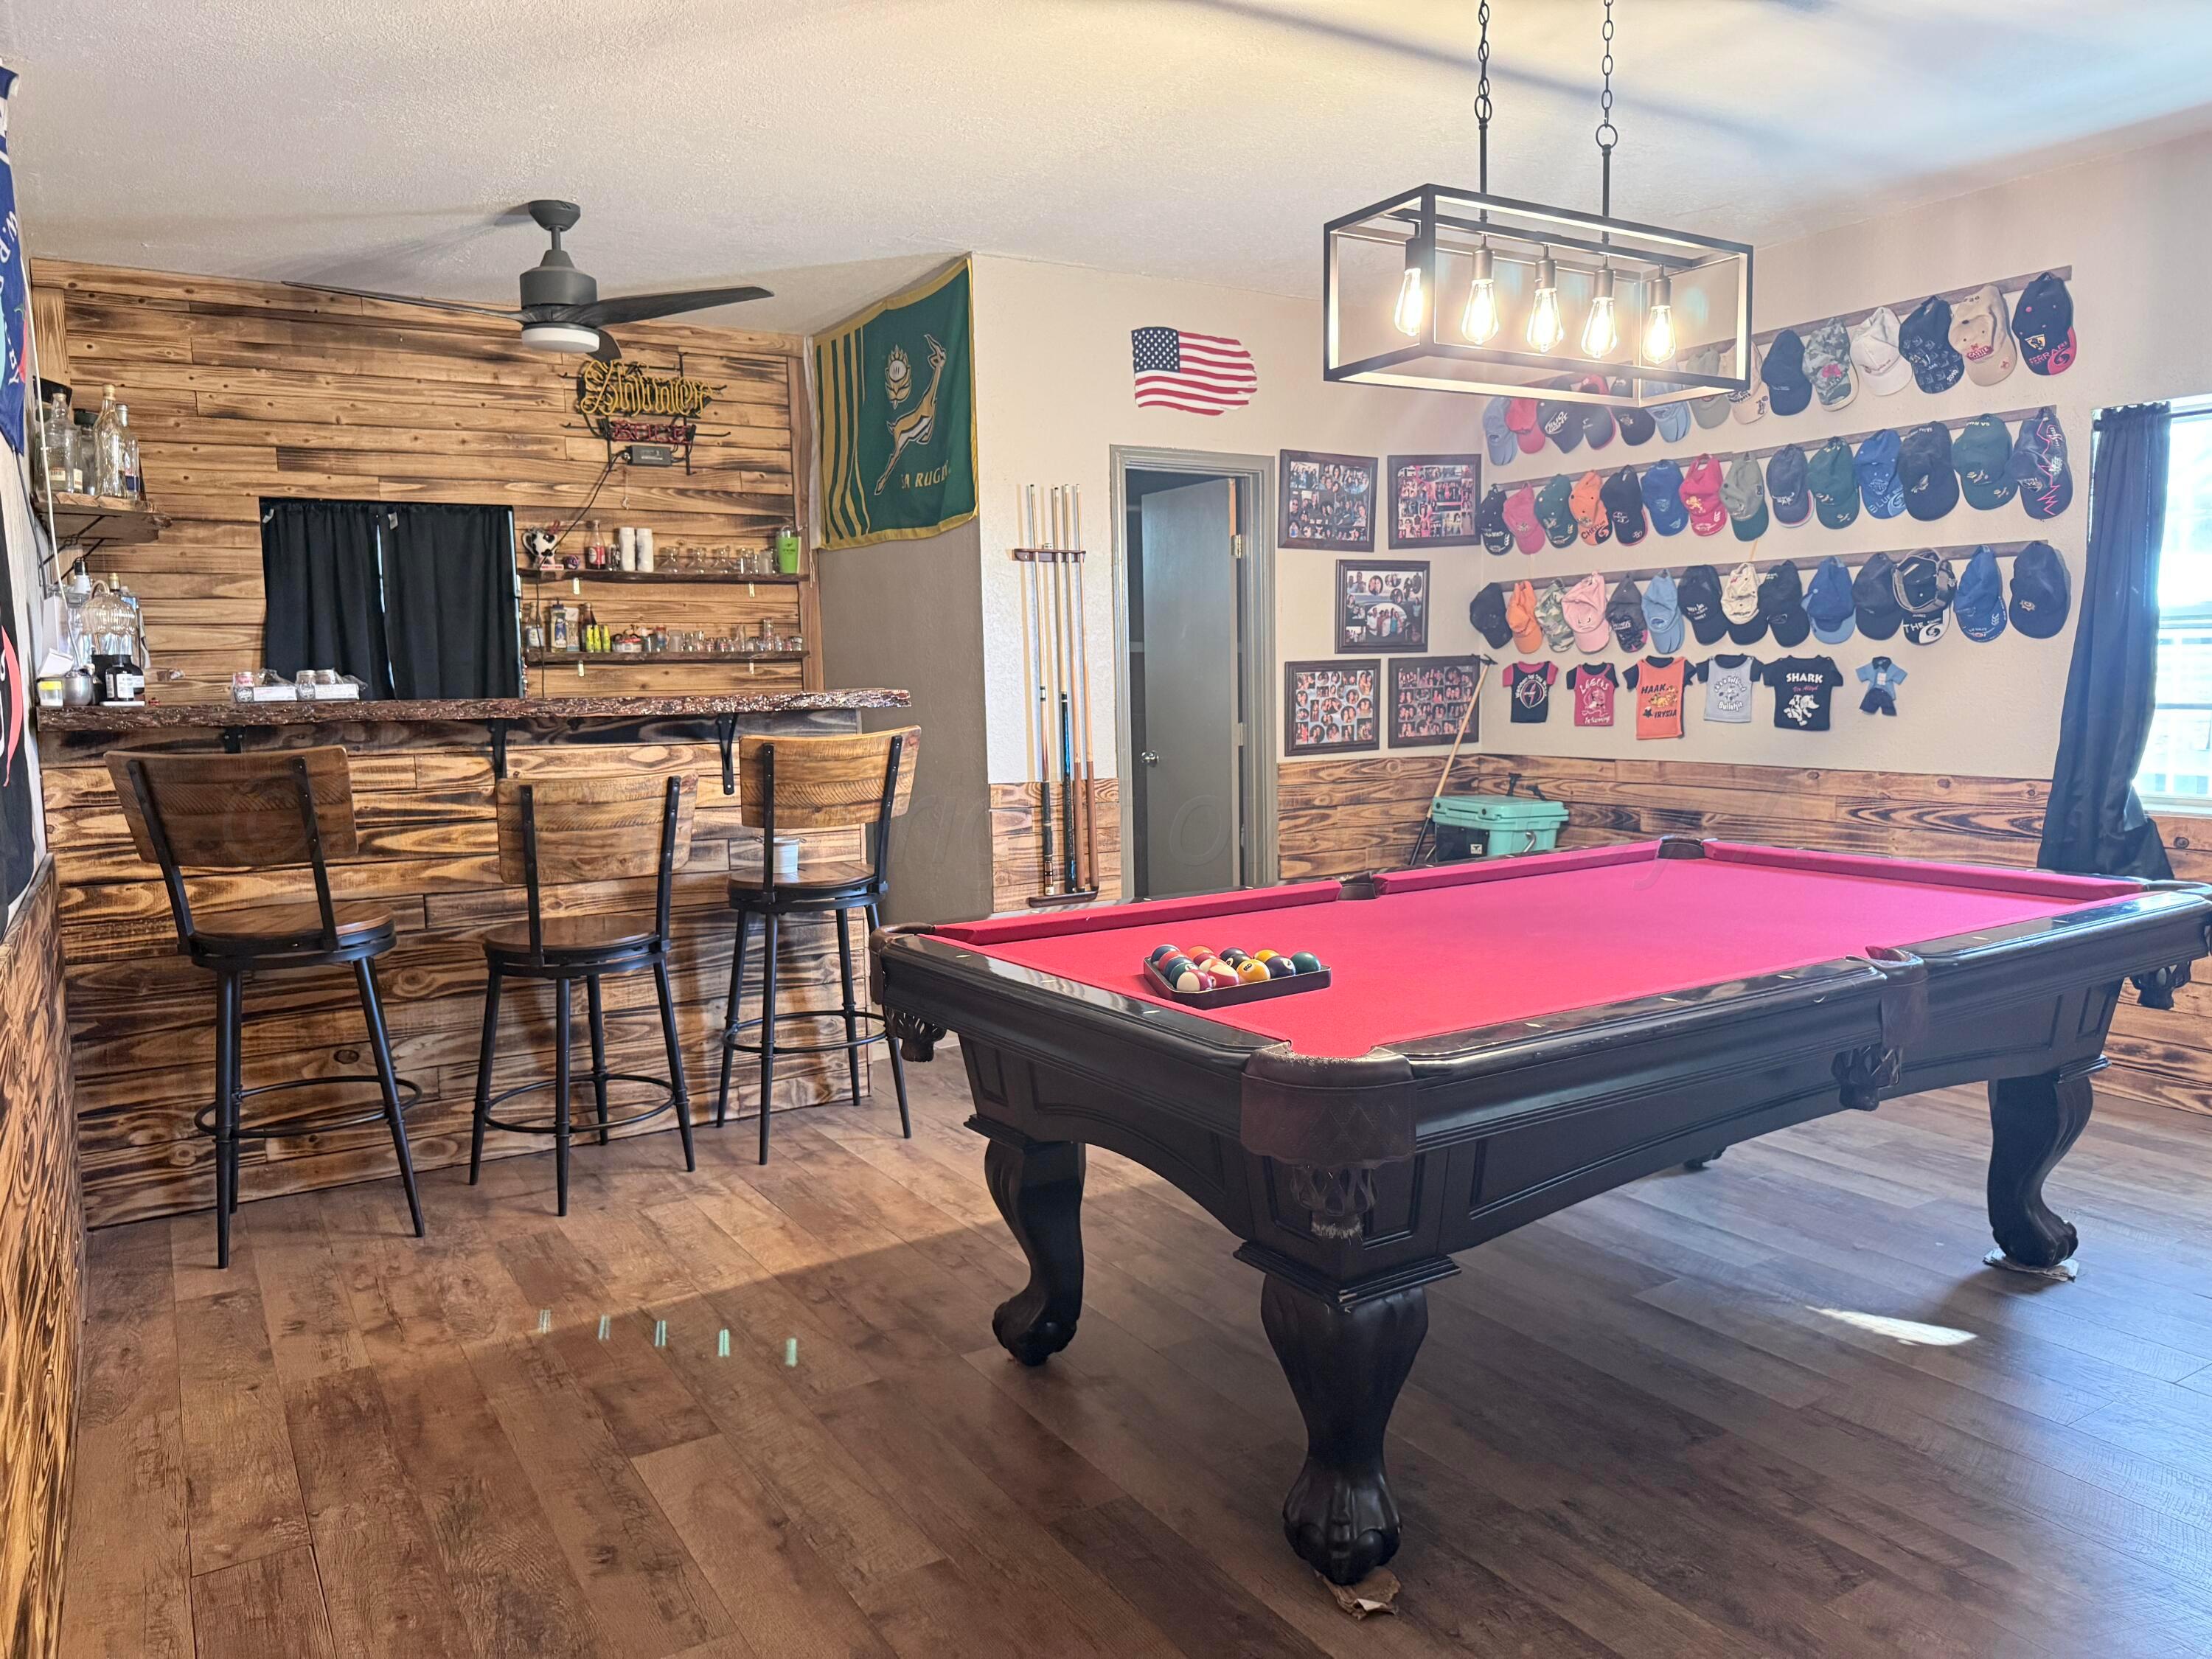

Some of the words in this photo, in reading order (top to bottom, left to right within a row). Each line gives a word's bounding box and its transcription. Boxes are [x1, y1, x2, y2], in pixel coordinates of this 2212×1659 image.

[581, 360, 714, 417] Shiner
[1786, 672, 1823, 684] SHARK
[1641, 684, 1666, 694] HAAK
